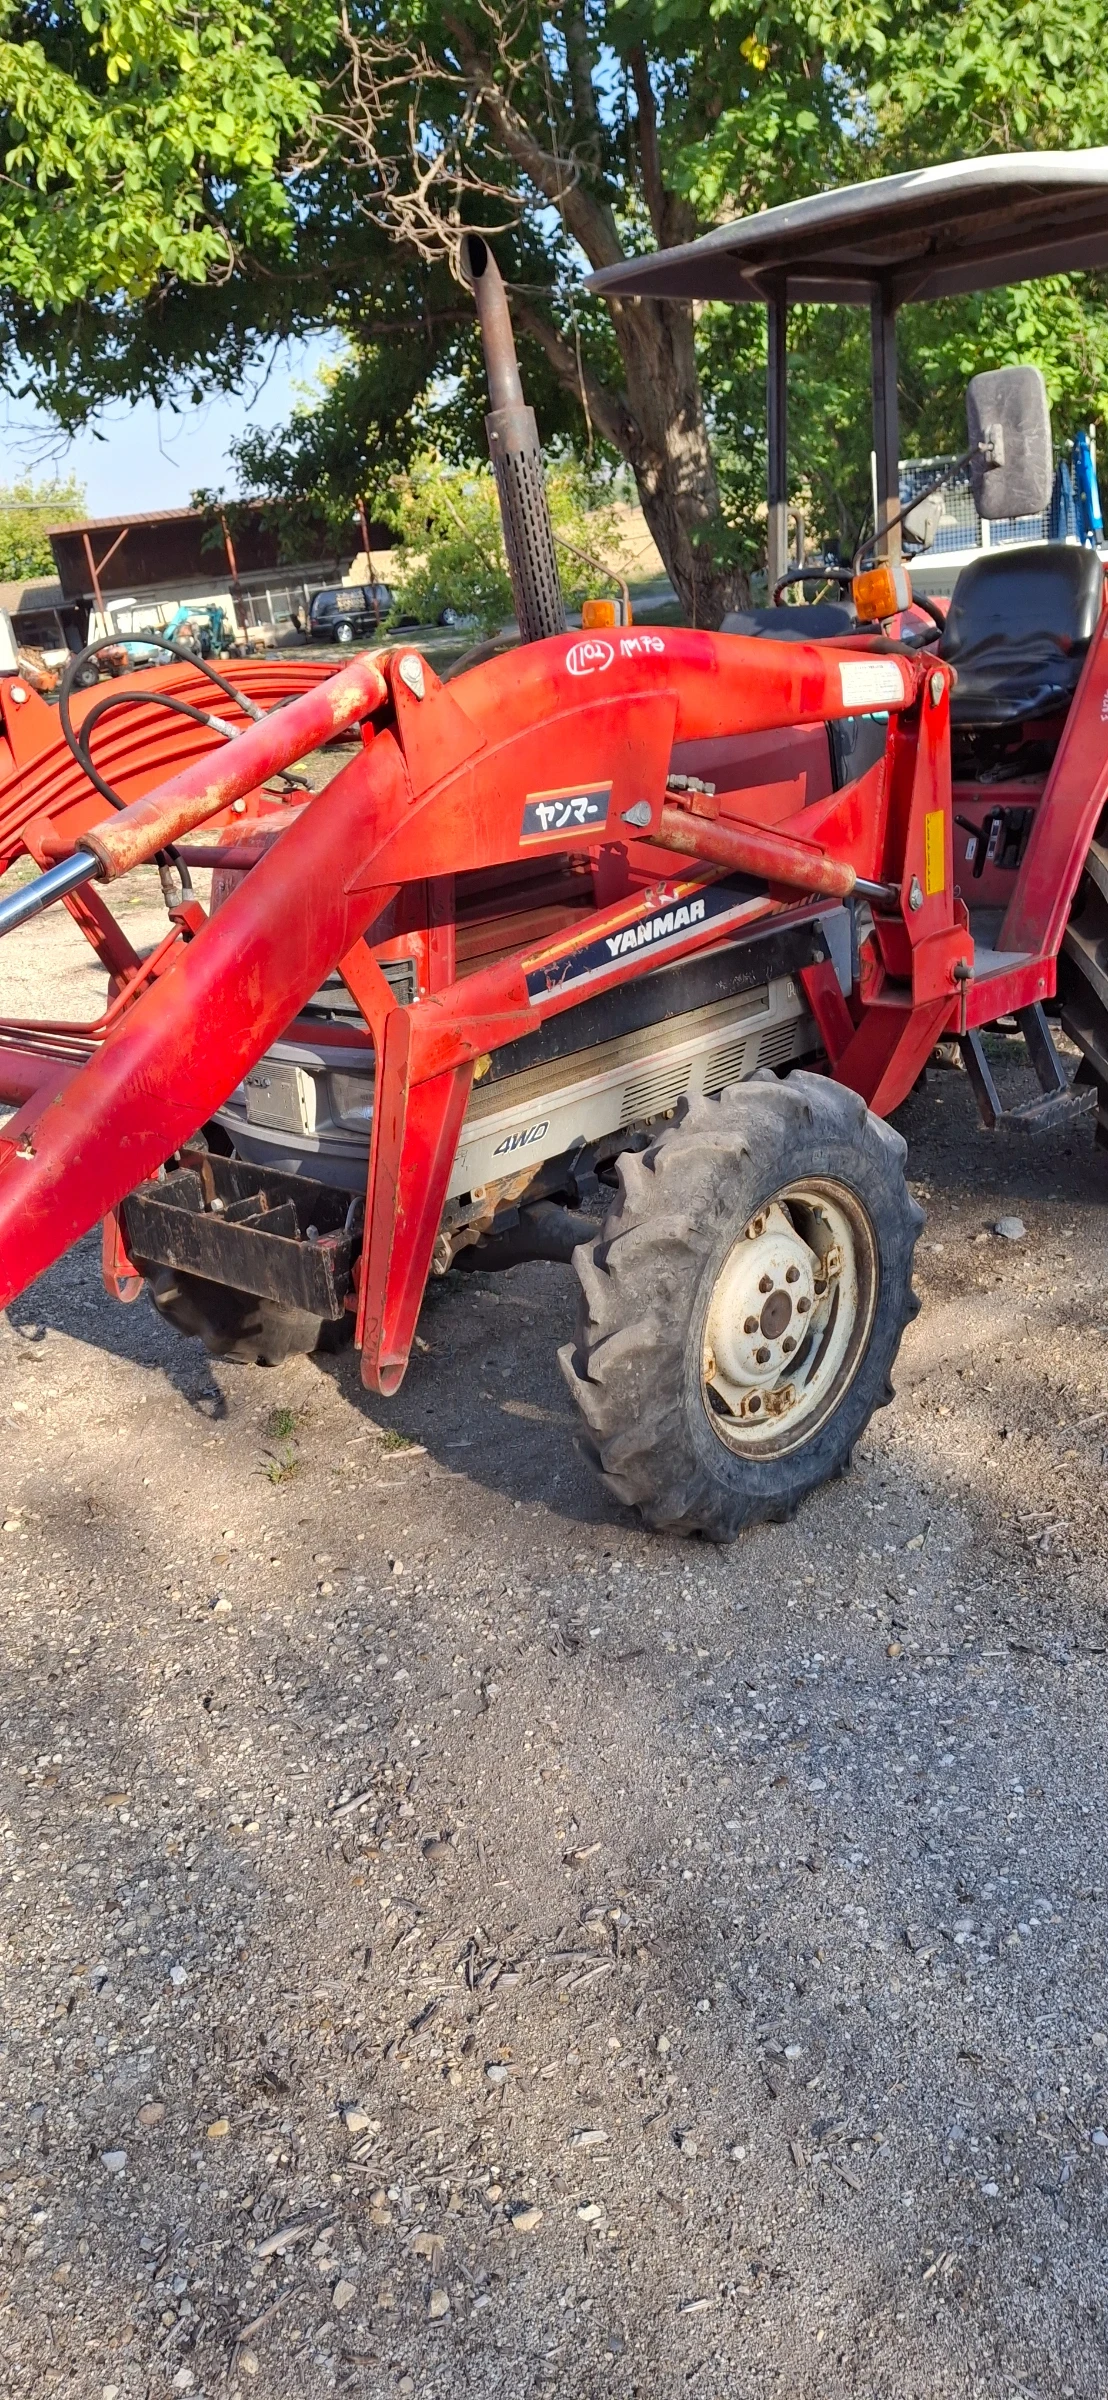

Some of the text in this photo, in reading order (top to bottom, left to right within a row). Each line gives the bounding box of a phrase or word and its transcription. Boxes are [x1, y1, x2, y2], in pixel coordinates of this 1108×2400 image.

[535, 796, 598, 831] ヤンマー
[605, 899, 705, 957] YANMAR
[493, 1121, 549, 1156] 4WD
